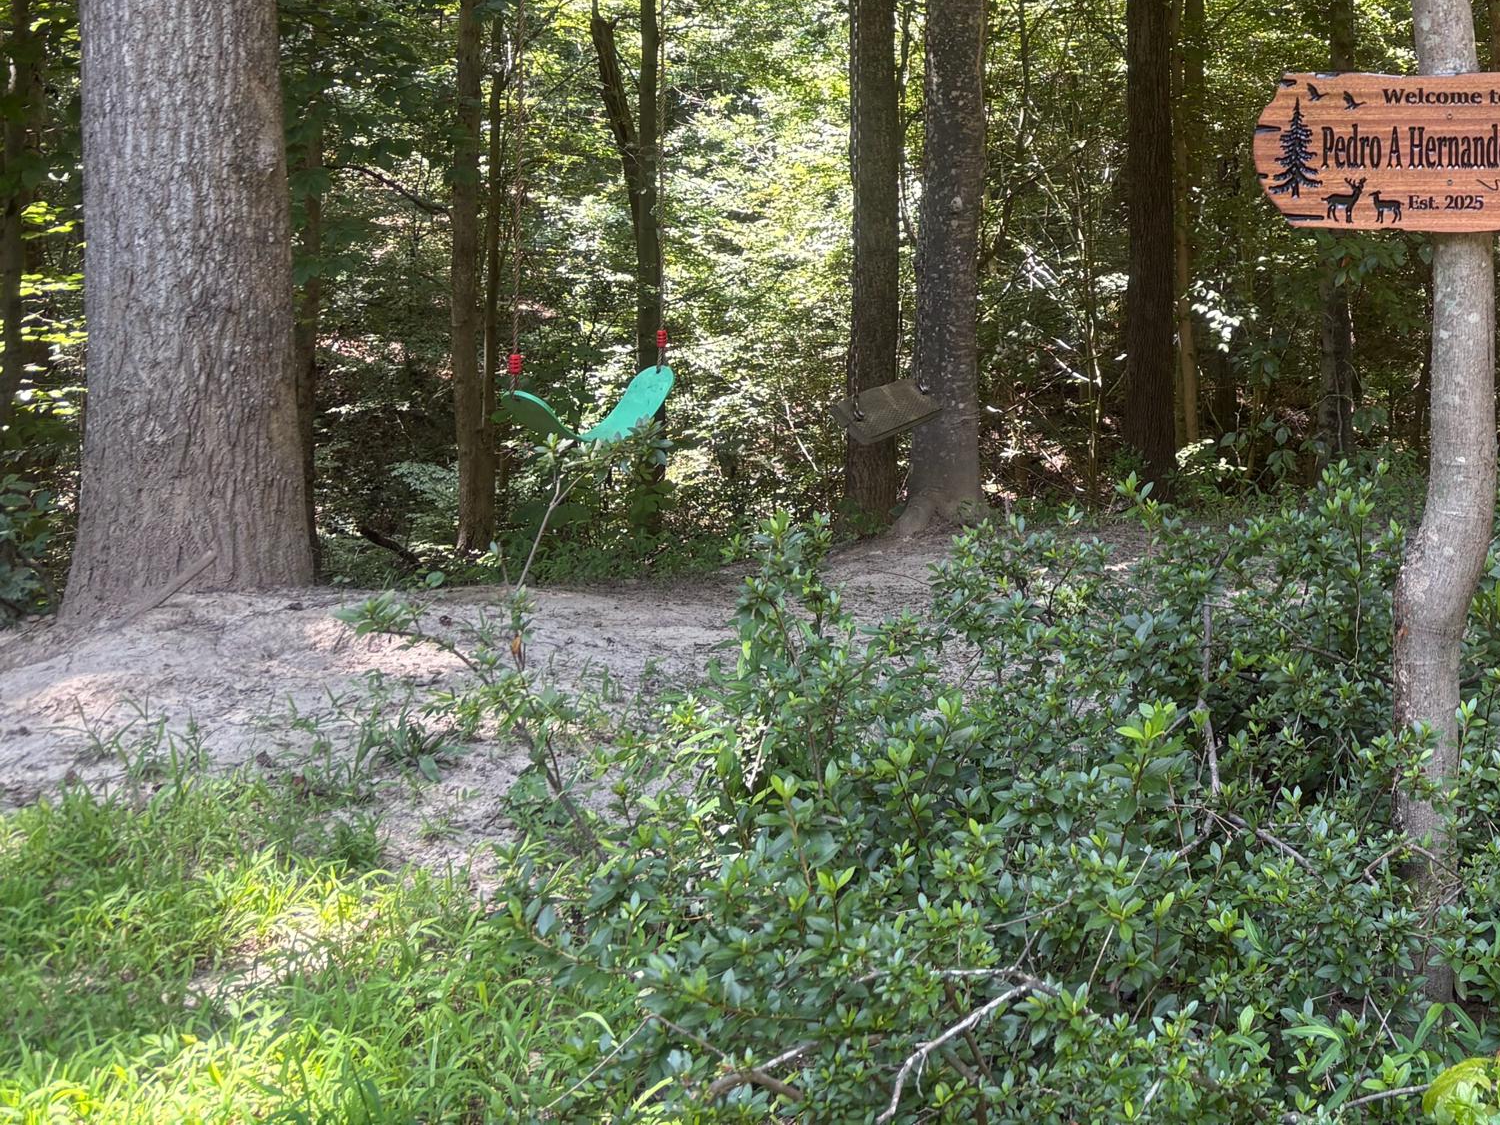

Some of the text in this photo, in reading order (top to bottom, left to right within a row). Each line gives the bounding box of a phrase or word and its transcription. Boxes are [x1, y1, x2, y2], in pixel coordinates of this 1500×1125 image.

[1382, 87, 1482, 106] Welcome
[1321, 123, 1382, 171] Pedro
[1386, 126, 1402, 170] A
[1408, 194, 1484, 211] Est. 2025
